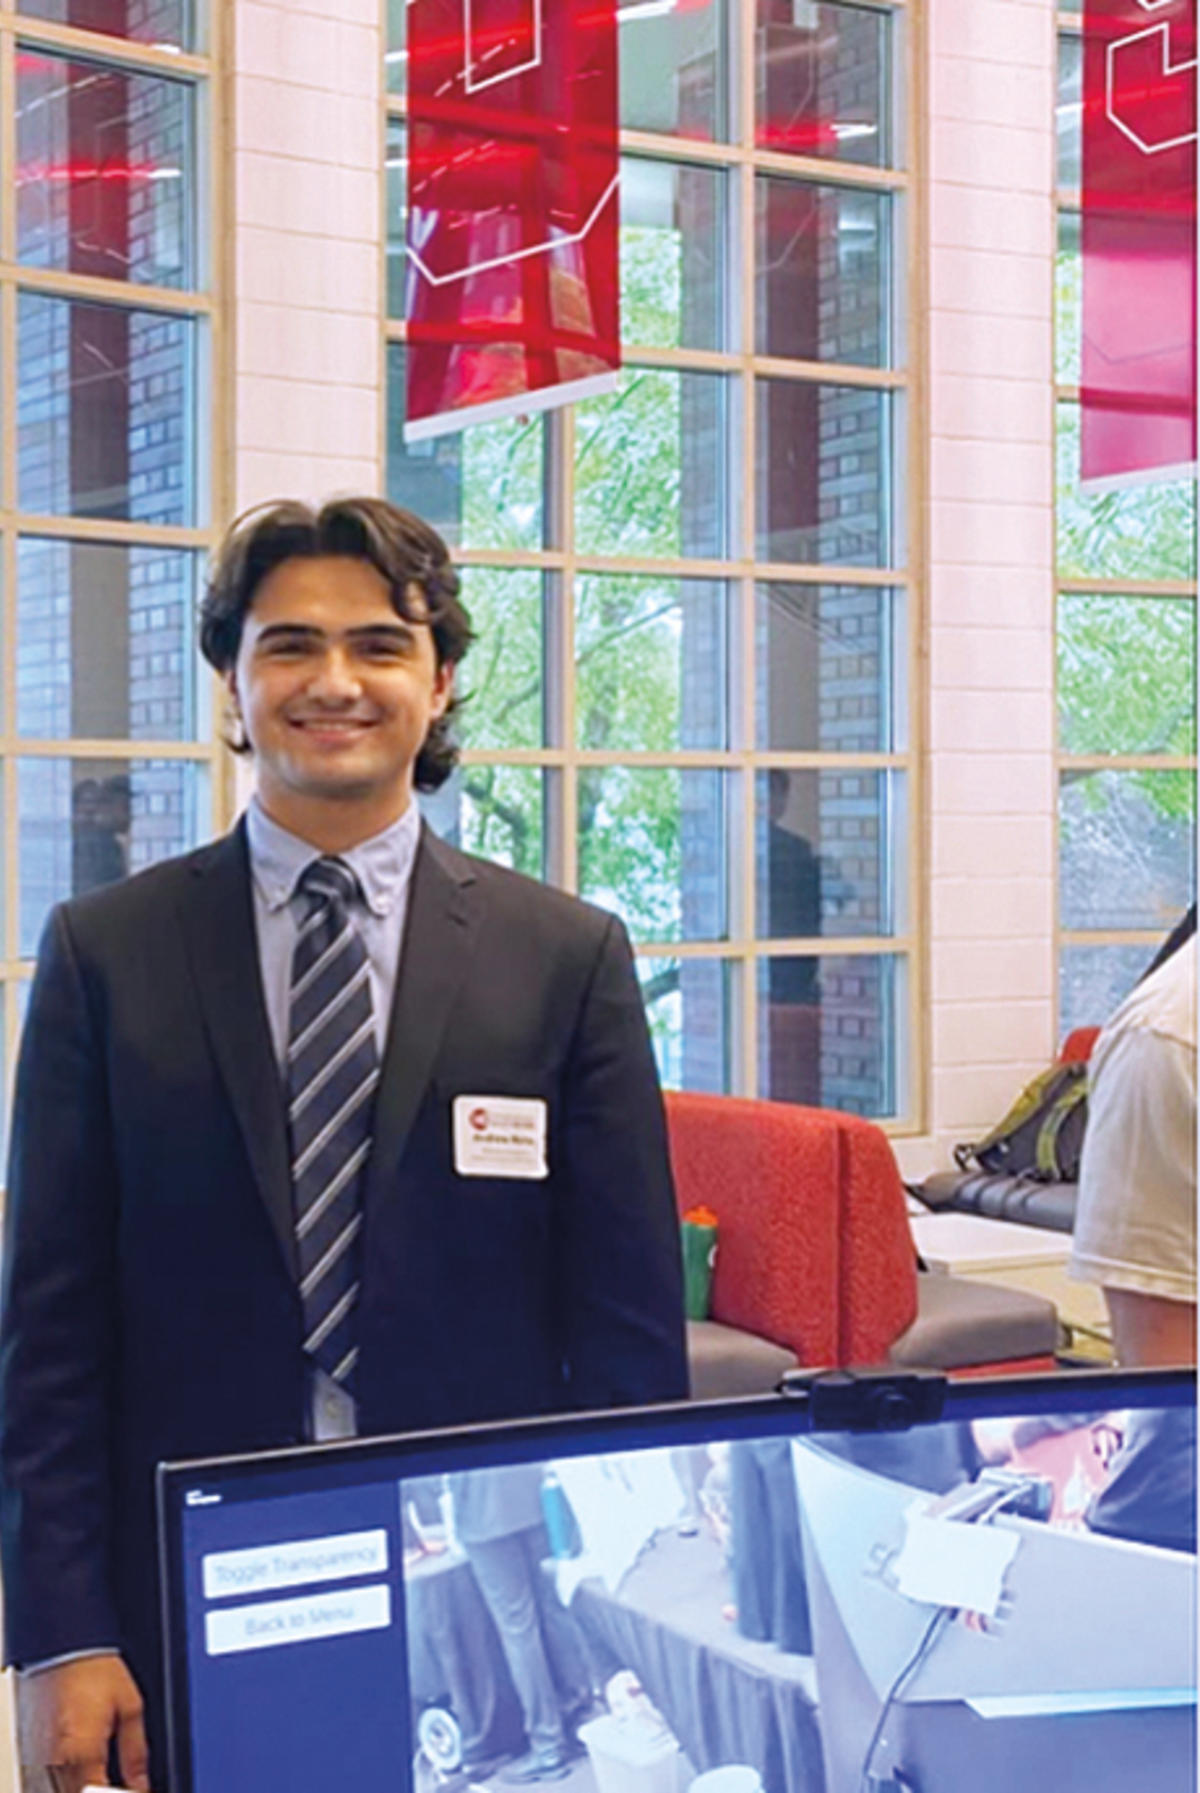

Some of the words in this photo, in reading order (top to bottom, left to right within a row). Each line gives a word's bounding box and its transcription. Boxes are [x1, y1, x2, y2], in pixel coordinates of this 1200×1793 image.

[214, 1563, 270, 1586] Toggle
[271, 1547, 379, 1574] Transparency
[244, 1616, 284, 1636] Back
[289, 1611, 304, 1628] to
[309, 1606, 354, 1625] Menu
